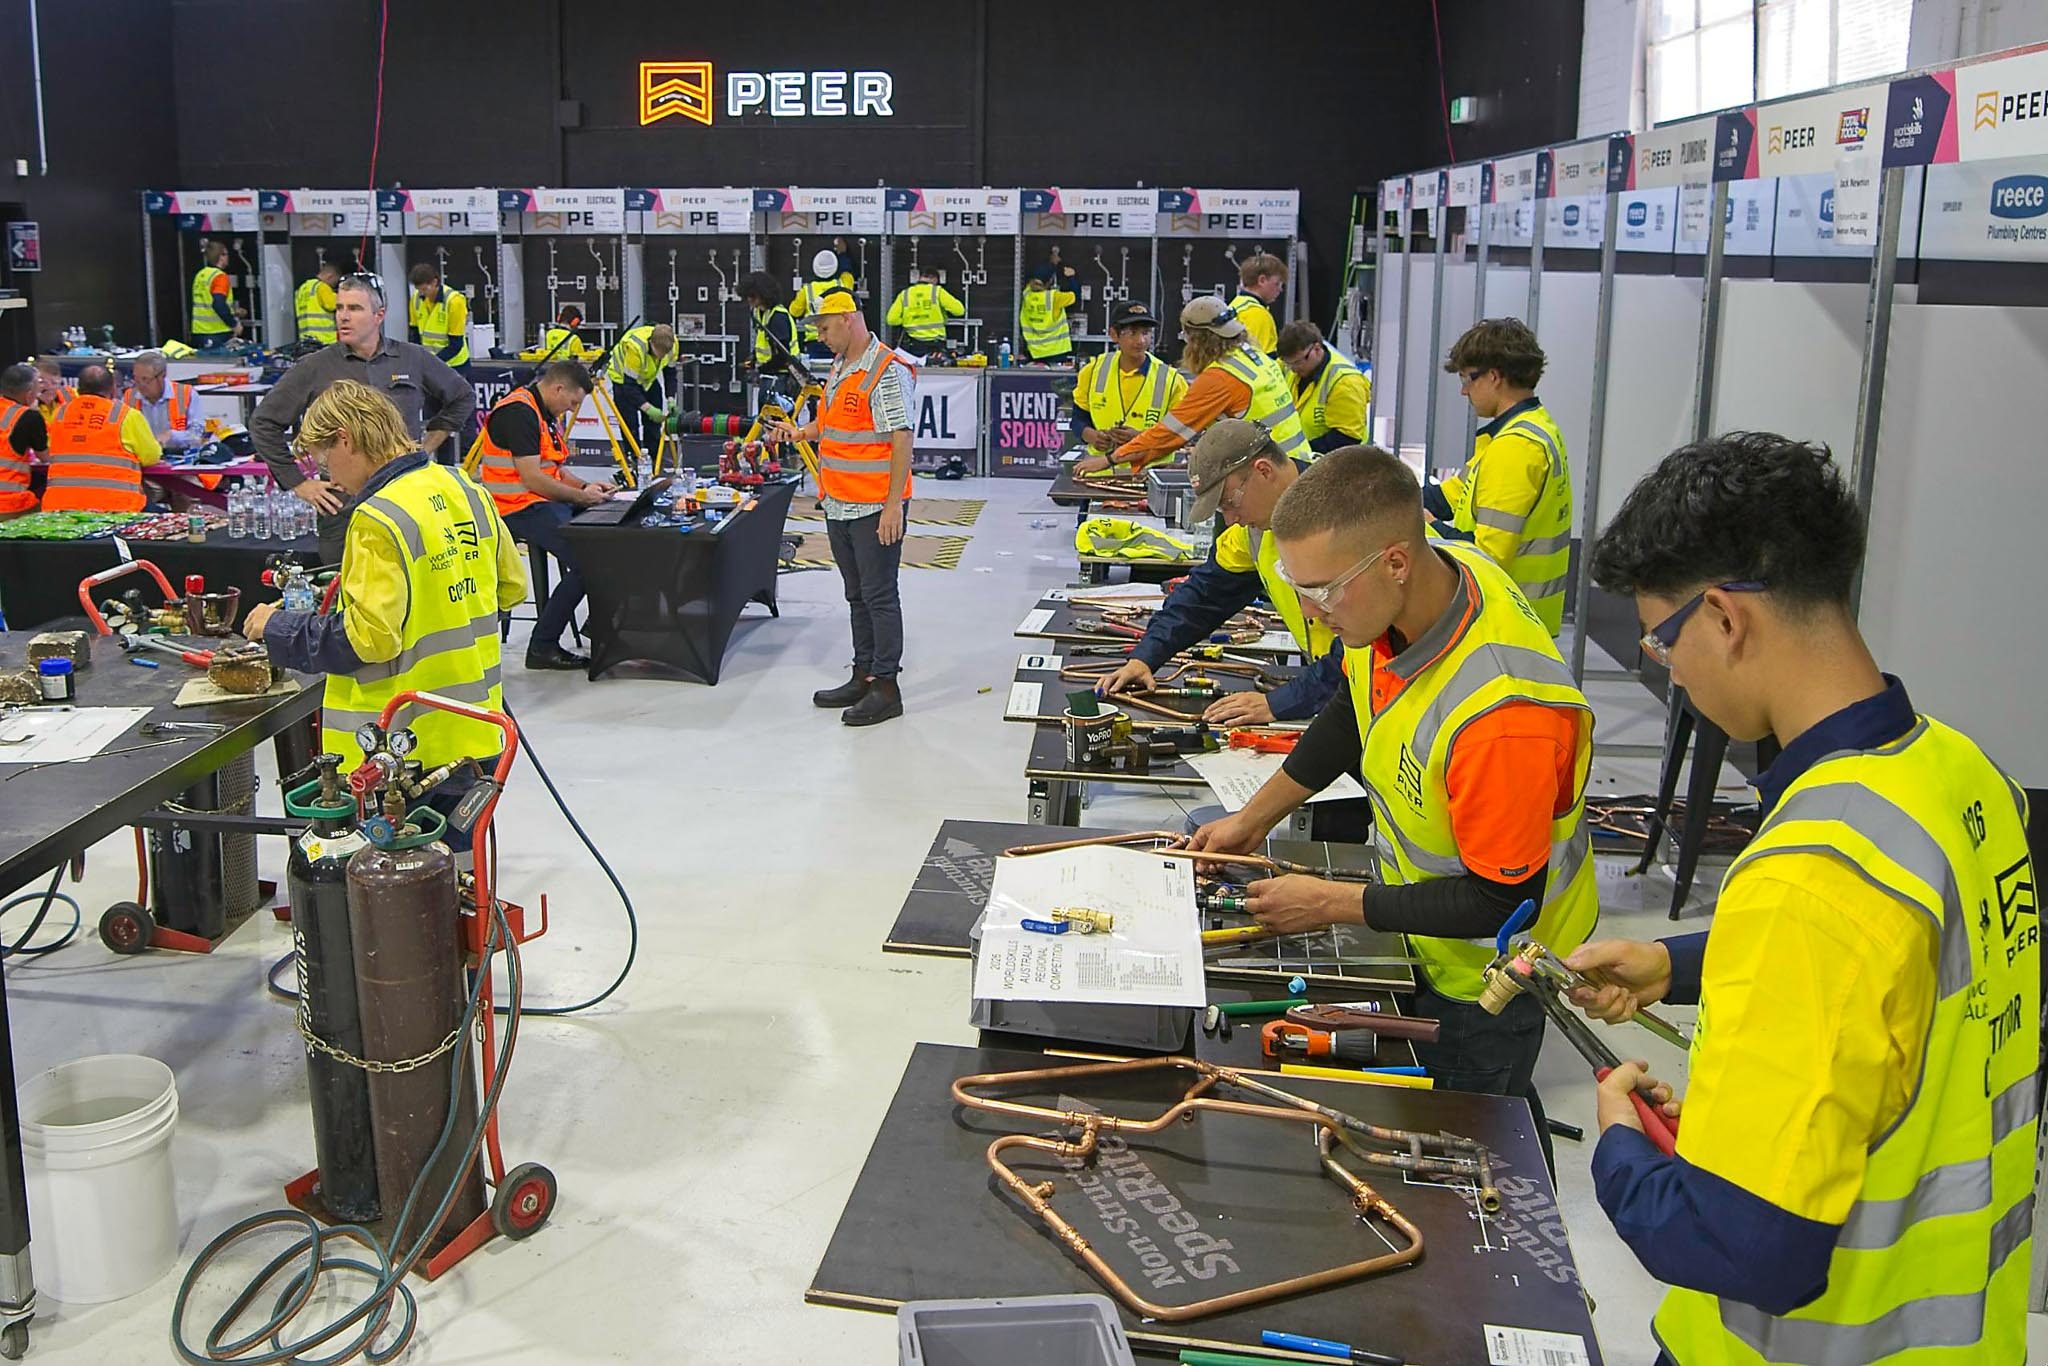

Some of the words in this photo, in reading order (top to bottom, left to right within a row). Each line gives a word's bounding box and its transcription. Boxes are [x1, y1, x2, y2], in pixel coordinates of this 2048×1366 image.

[727, 72, 893, 116] PEER
[1784, 127, 1815, 150] PEER
[1651, 149, 1672, 168] PEER
[846, 195, 877, 205] ELECTRICAL
[946, 197, 971, 205] PEER
[1117, 196, 1150, 206] ELECTRICAL
[1996, 186, 2046, 208] reece
[568, 212, 594, 226] PE
[690, 212, 719, 226] PE
[943, 212, 986, 227] PEE
[1074, 213, 1121, 228] PEE
[1208, 213, 1263, 230] PEE
[1987, 225, 2017, 242] Plumbing
[2020, 225, 2047, 241] Centres
[1001, 391, 1059, 420] EVENT
[914, 395, 956, 439] AL
[1086, 729, 1112, 743] YoPRO
[1003, 940, 1019, 990] WORLDSKILLS
[1020, 944, 1033, 984] AUSTRALIA
[1035, 946, 1048, 984] REGIONAL
[1049, 942, 1063, 991] COMPETITION
